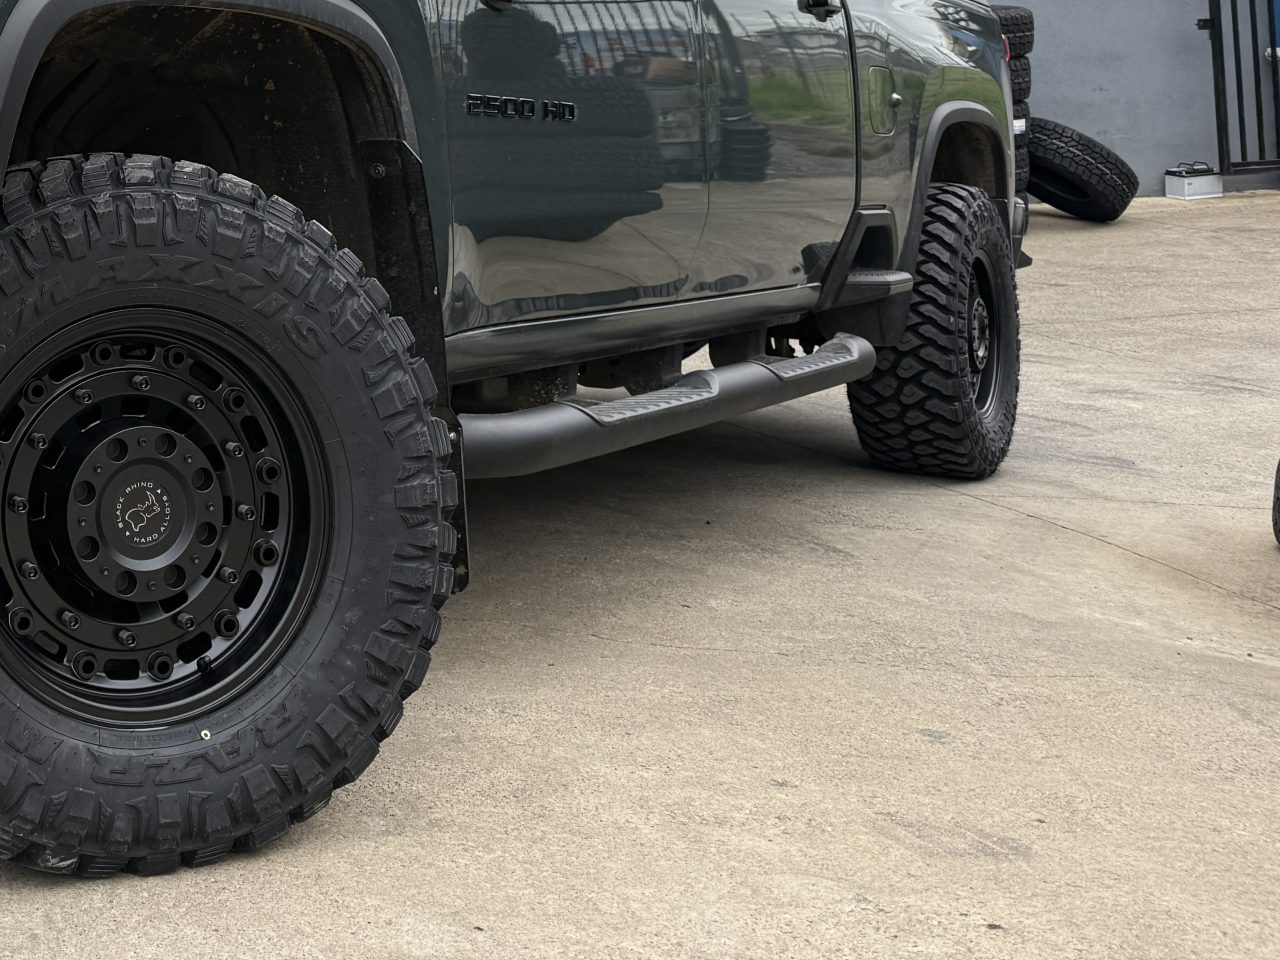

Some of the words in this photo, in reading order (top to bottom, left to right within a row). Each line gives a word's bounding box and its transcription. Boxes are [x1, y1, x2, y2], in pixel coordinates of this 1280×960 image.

[466, 93, 535, 117] 2500
[542, 99, 576, 121] HD
[116, 496, 125, 529] BLACK
[125, 481, 153, 494] RHINO
[133, 533, 158, 543] HARD
[160, 495, 171, 533] ALLOYS
